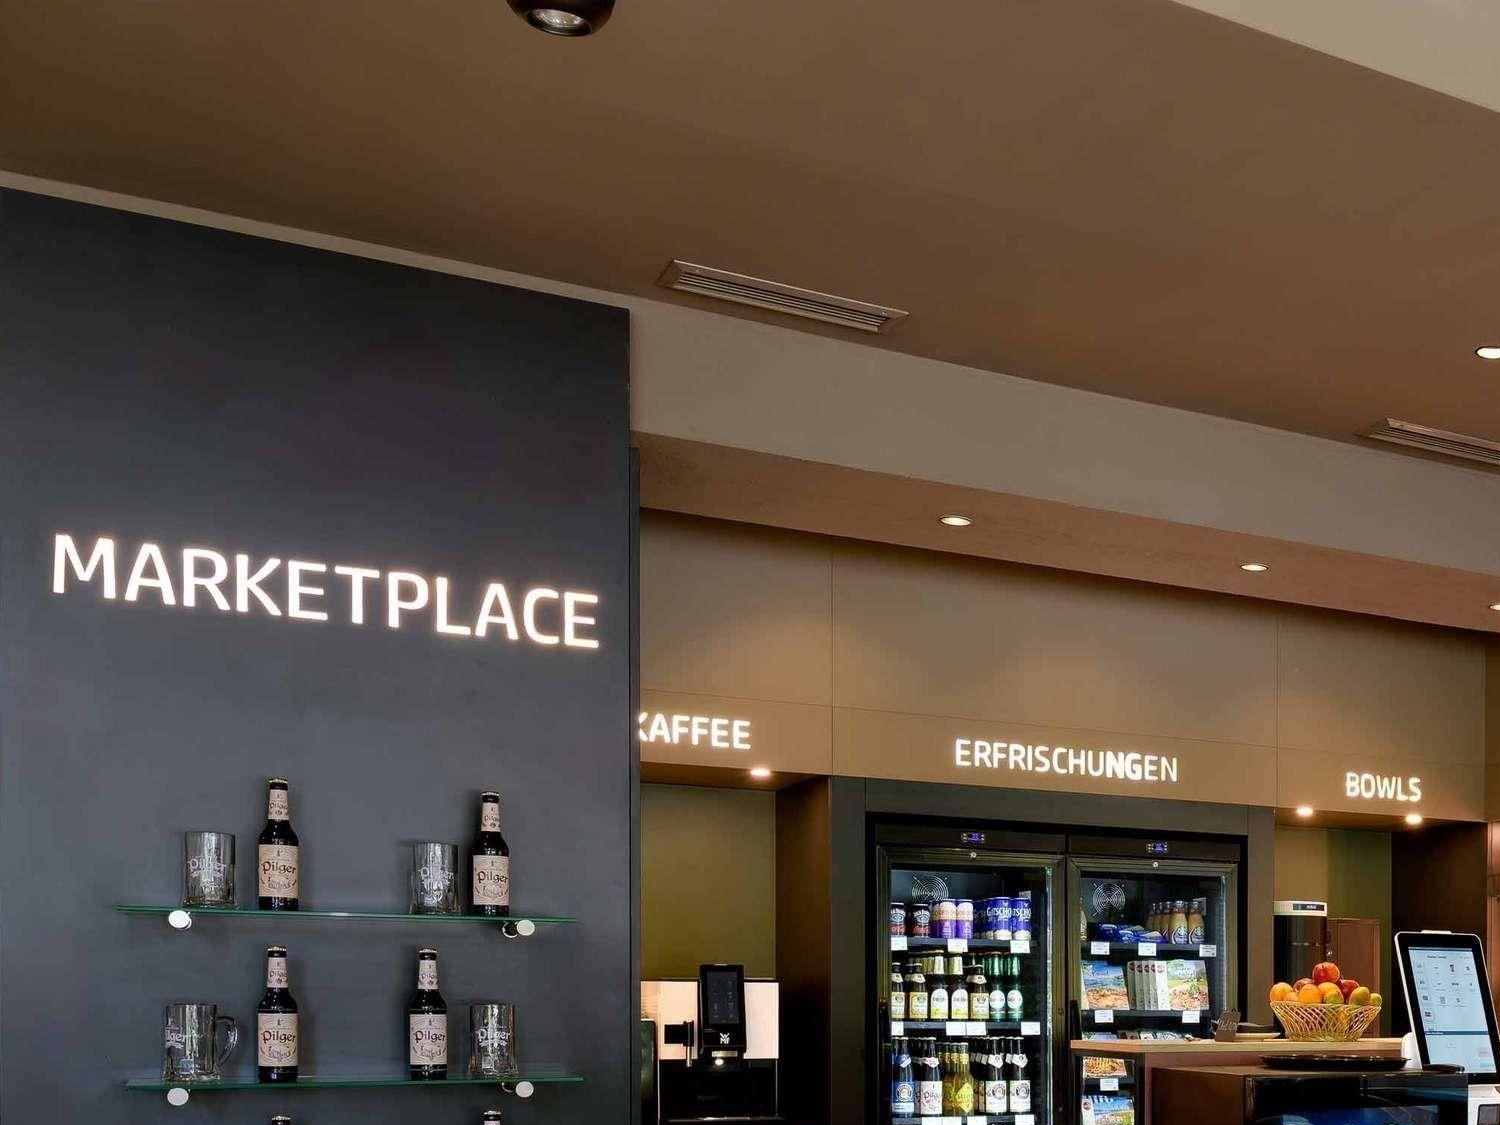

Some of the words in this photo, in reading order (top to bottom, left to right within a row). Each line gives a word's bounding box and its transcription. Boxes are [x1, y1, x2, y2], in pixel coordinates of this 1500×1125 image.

[52, 532, 601, 650] MARKETPLACE
[954, 737, 1179, 783] ERFRISCHUNGEN
[1344, 771, 1422, 803] BOWLS
[260, 861, 297, 875] Pilger
[476, 870, 509, 884] Pilger
[261, 1030, 297, 1044] Pilger
[414, 1030, 447, 1044] Pilger
